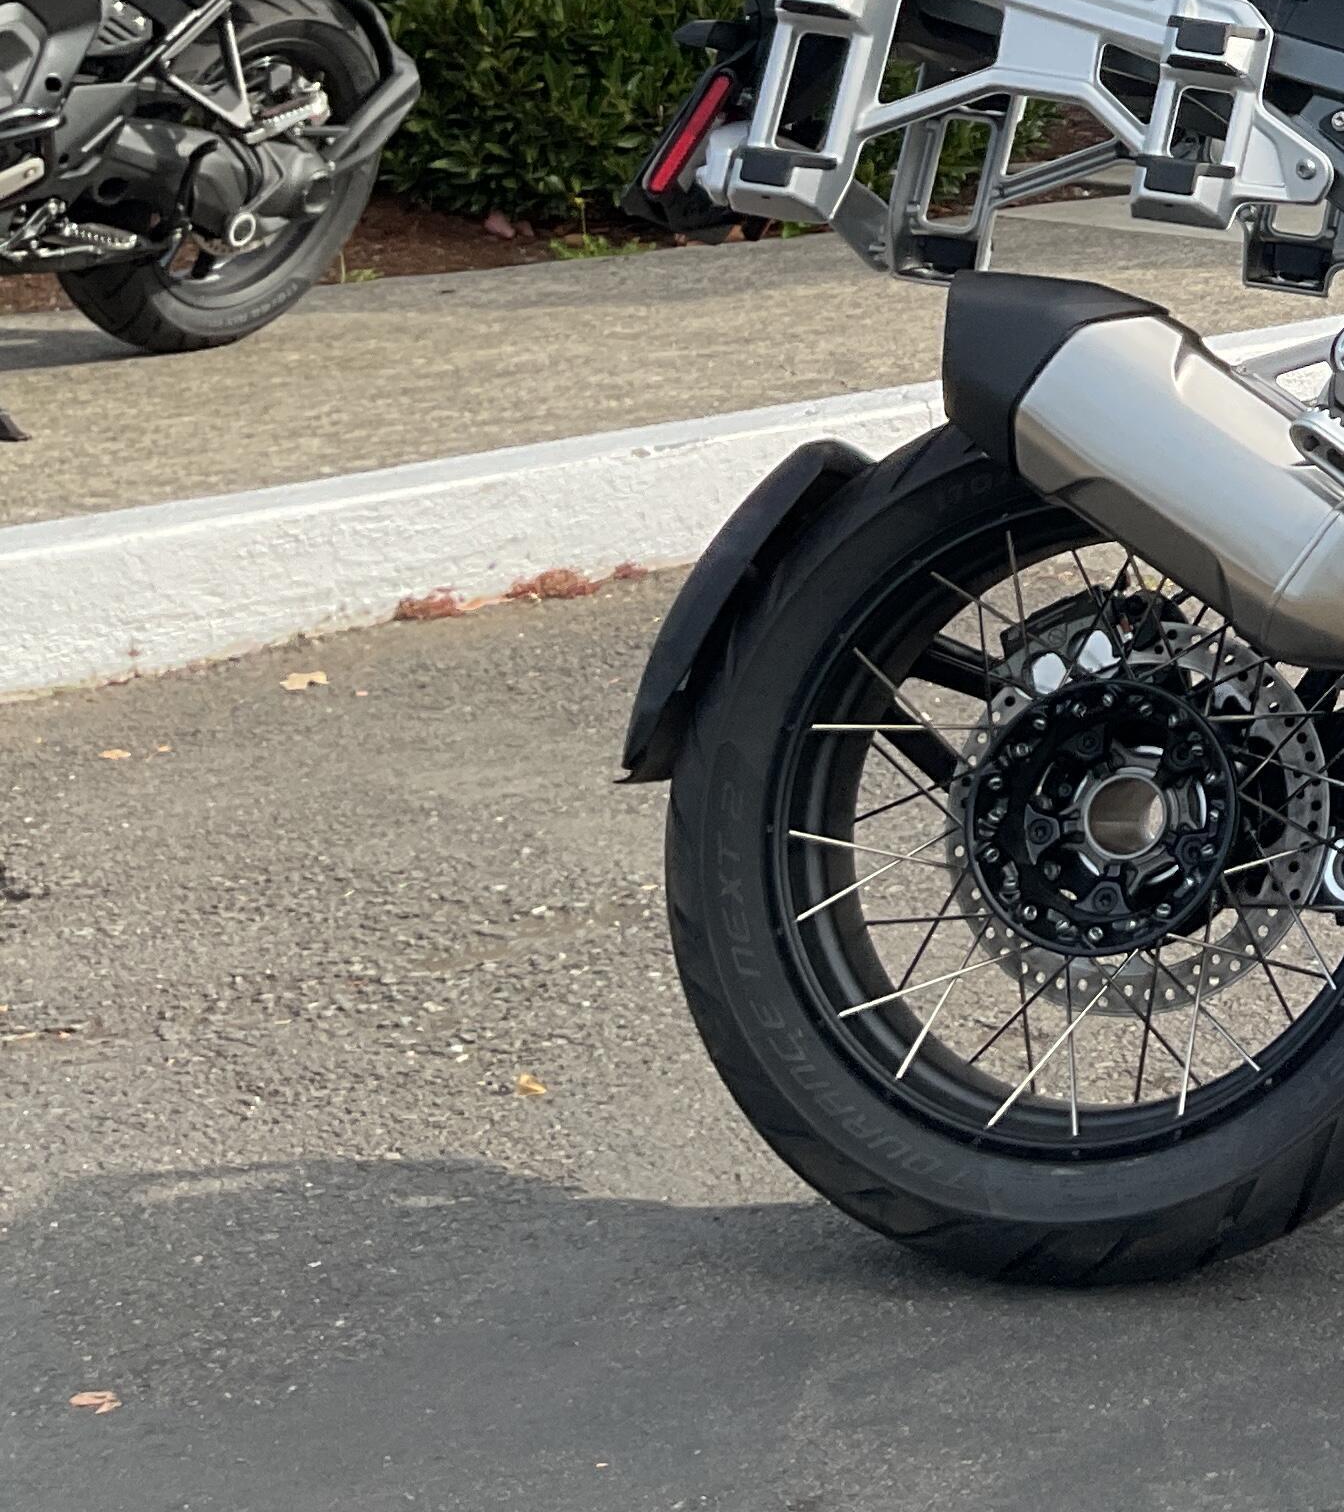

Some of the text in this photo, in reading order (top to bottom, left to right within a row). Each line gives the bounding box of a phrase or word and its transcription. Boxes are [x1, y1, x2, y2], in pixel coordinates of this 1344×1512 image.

[717, 781, 972, 1189] TOURANCE NEXT 2
